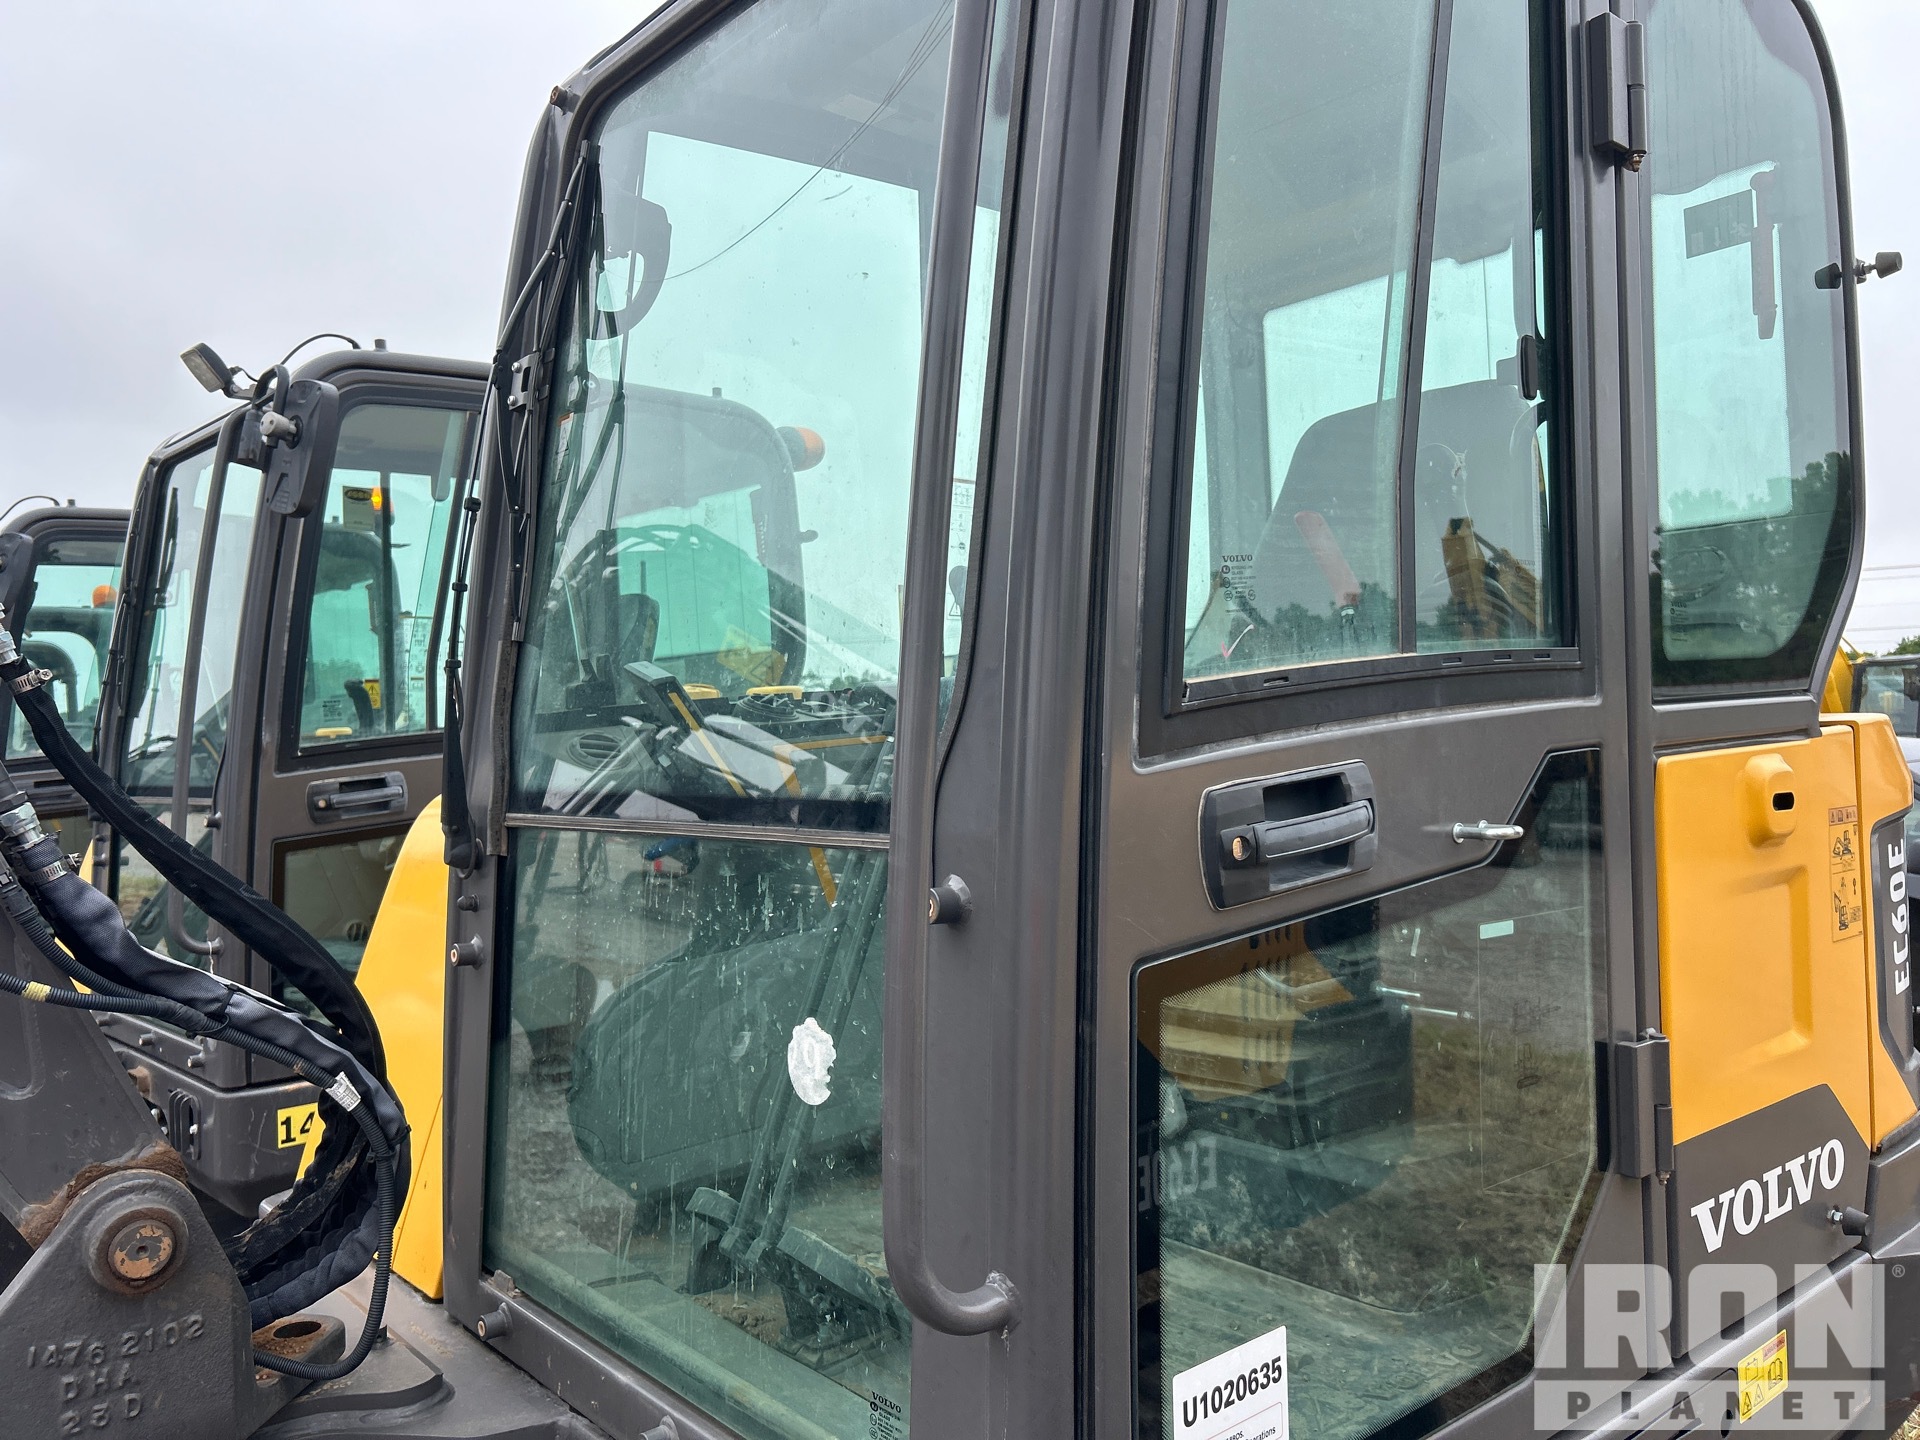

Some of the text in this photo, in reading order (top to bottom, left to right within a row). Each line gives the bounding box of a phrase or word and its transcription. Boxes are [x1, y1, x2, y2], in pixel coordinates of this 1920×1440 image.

[1222, 554, 1253, 562] VOLVO
[1888, 838, 1910, 995] EC60E
[1690, 1138, 1845, 1253] VOLVO
[121, 1313, 205, 1357] 2102
[872, 1391, 901, 1413] VOLVO
[1182, 1356, 1282, 1428] U1020635
